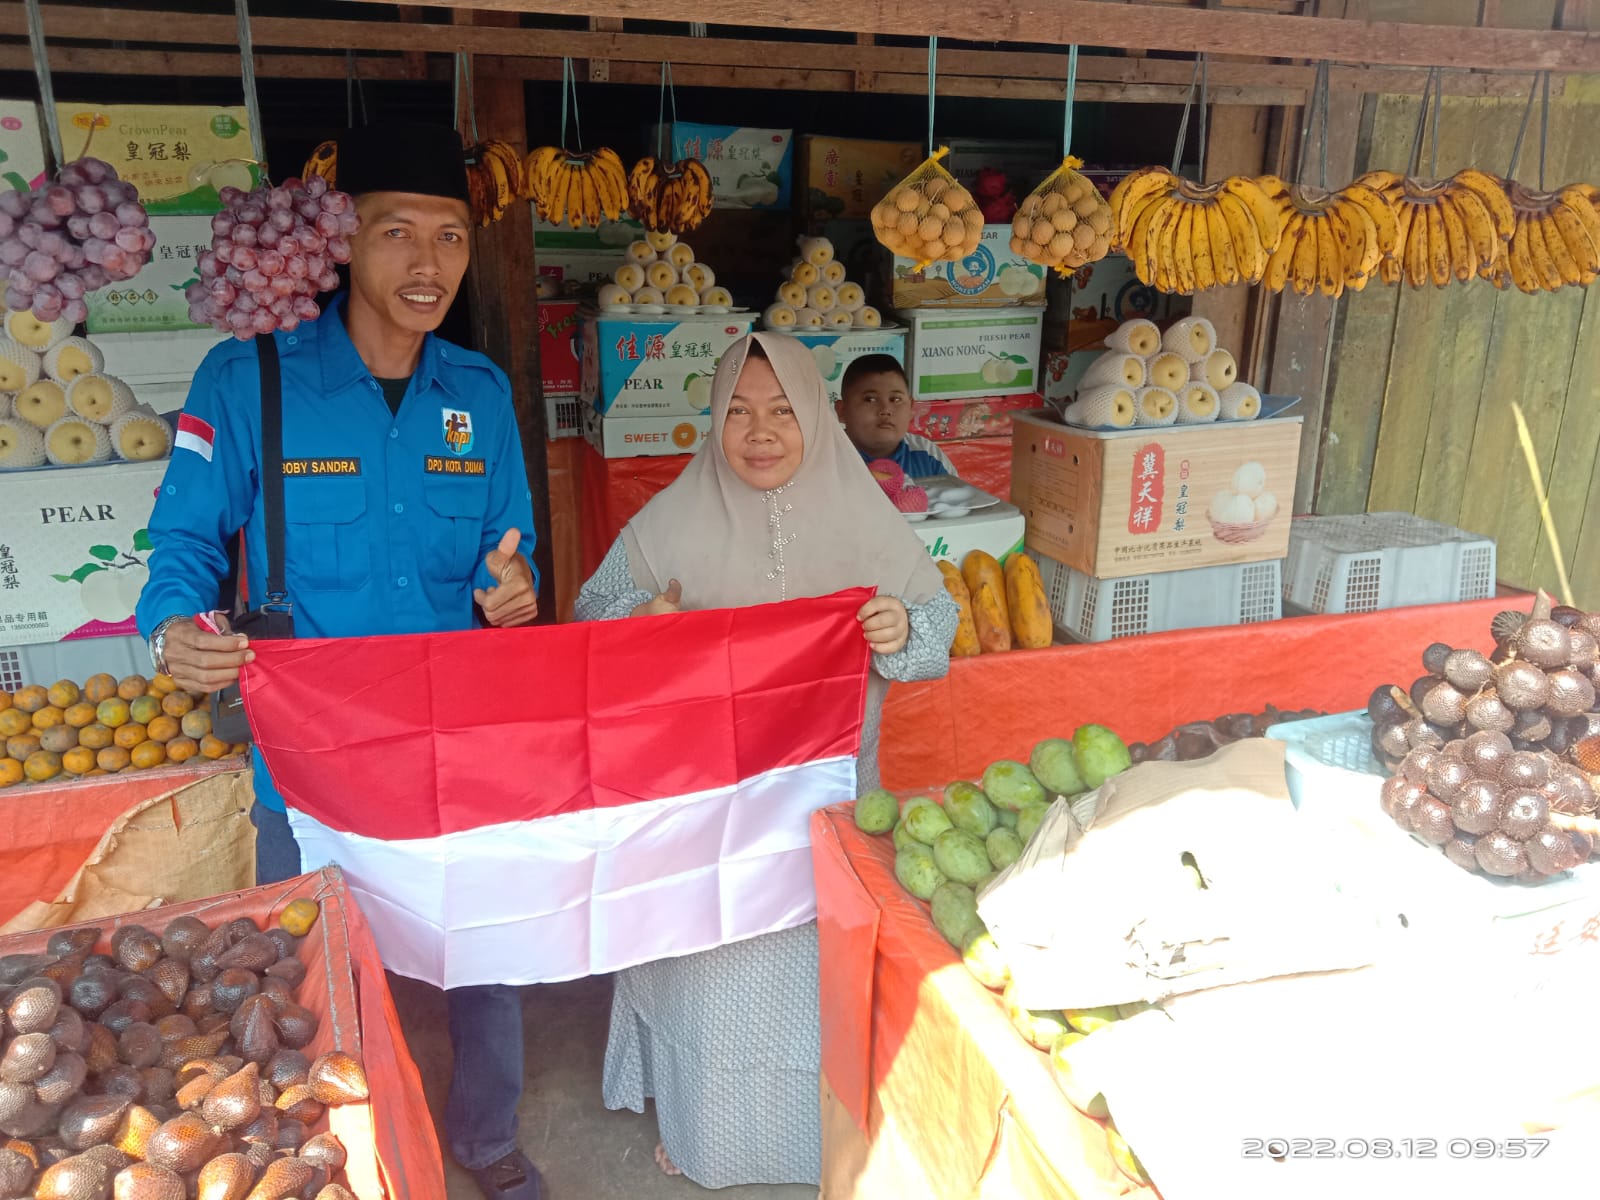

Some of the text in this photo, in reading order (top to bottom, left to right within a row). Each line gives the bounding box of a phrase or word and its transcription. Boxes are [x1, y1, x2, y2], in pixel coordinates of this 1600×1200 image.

[125, 140, 192, 162] 皇冠梨
[979, 332, 1031, 343] FRESH PEAR
[615, 332, 714, 361] 佳源 皇冠梨
[921, 344, 986, 358] XIANG NONG
[624, 378, 664, 391] PEAR
[624, 432, 669, 443] SWEET
[311, 460, 356, 473] SANDRA
[427, 458, 485, 474] DPD KOTA DUMAI
[40, 503, 116, 525] PEAR
[1173, 484, 1189, 532] 皇冠梨
[0, 543, 21, 590] 皇冠梨
